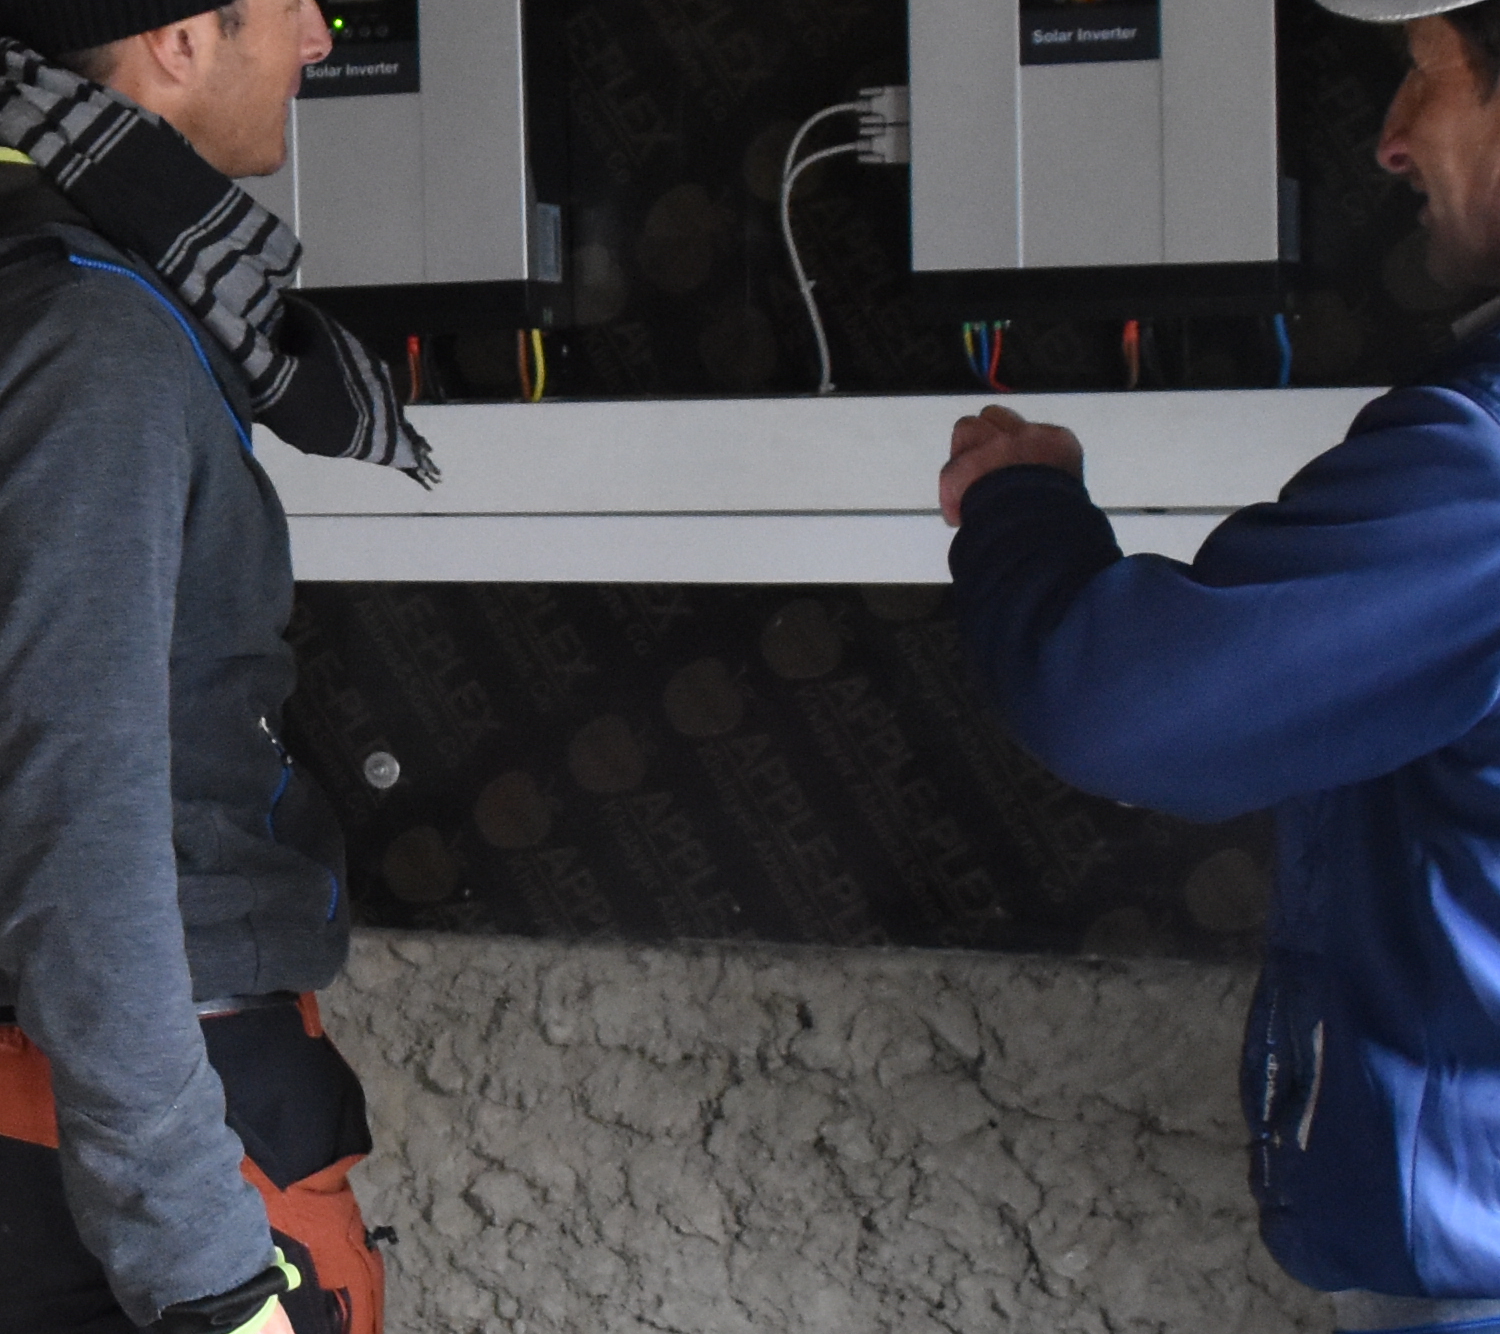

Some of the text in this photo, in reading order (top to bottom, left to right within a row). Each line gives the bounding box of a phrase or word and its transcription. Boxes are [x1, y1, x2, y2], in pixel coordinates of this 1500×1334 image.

[1032, 26, 1138, 44] Solar Inverter
[305, 62, 399, 79] Solar Inverter
